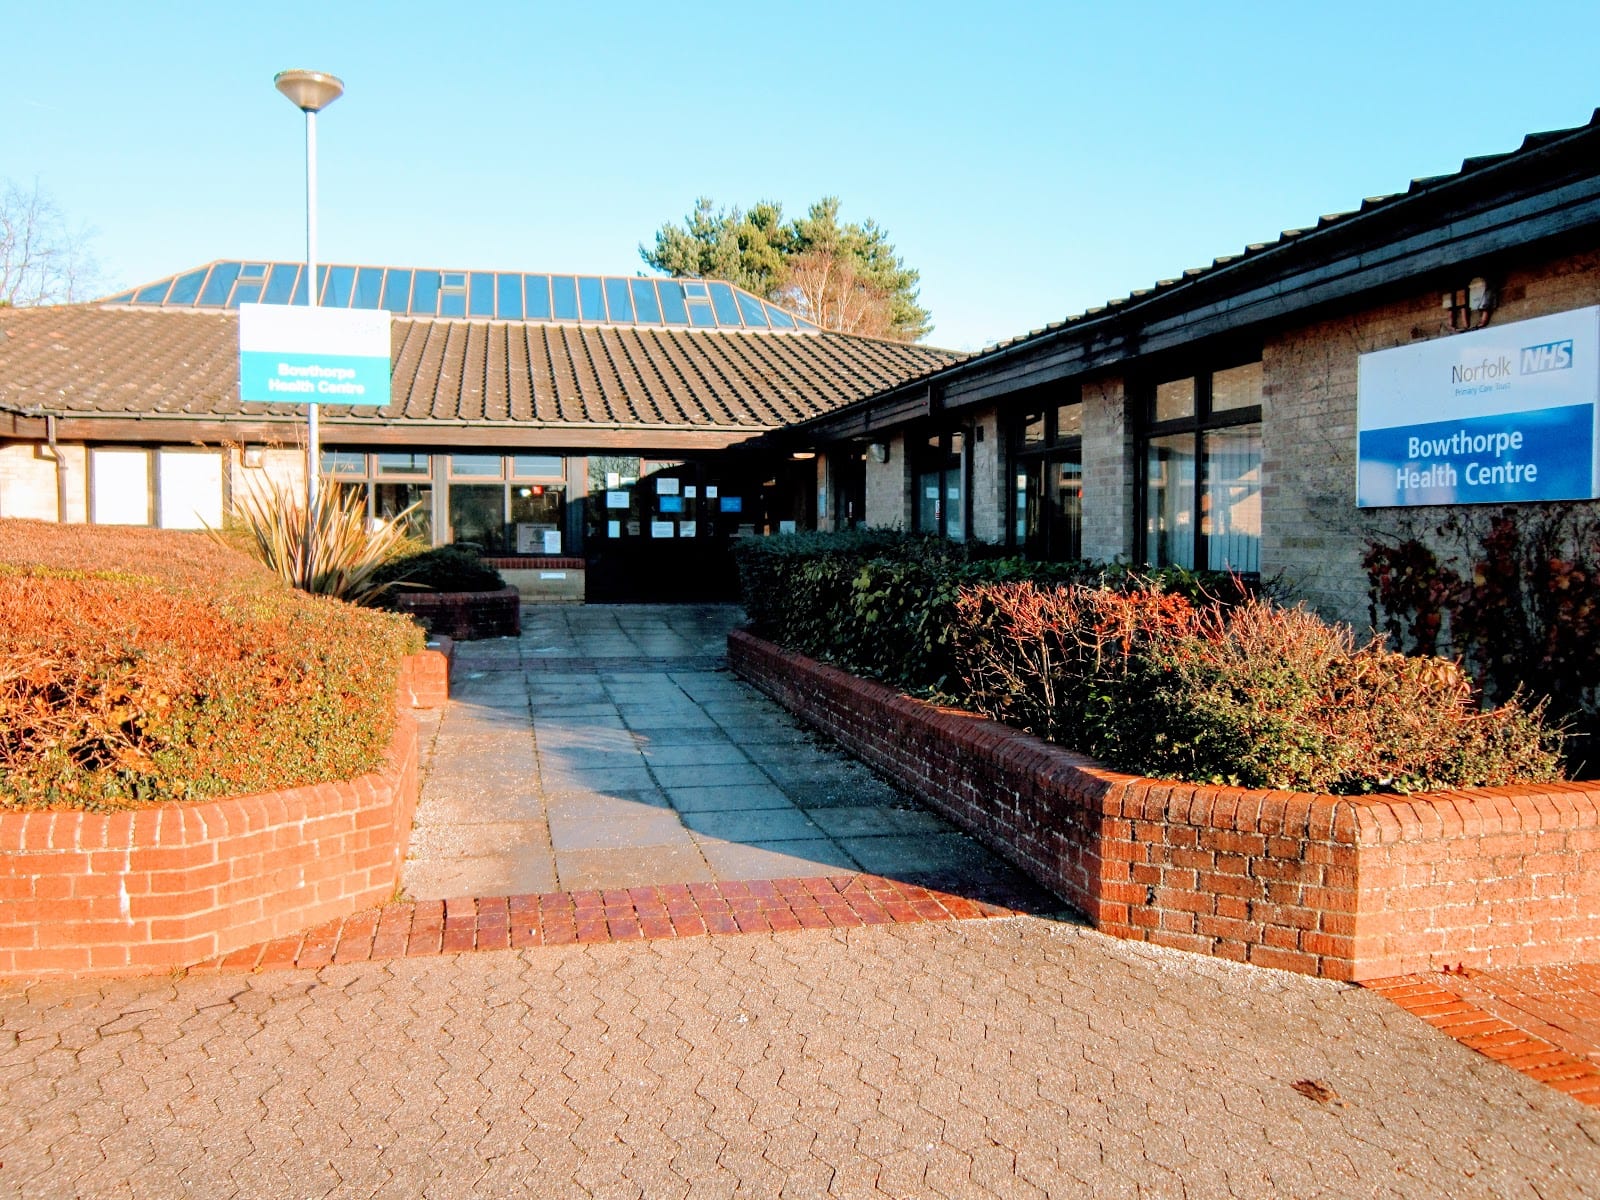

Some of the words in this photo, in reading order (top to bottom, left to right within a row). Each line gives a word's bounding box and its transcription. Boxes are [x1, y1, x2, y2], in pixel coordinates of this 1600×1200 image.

[278, 363, 356, 380] Bowthorpe
[1452, 355, 1511, 384] Norfolk
[1521, 341, 1572, 374] NHS
[269, 379, 314, 392] Health
[318, 381, 365, 394] Centre
[1455, 386, 1478, 397] Primary
[1479, 384, 1493, 394] Care
[1408, 430, 1523, 458] Bowthorpe
[1396, 462, 1458, 489] Health
[1465, 461, 1538, 486] Centre
